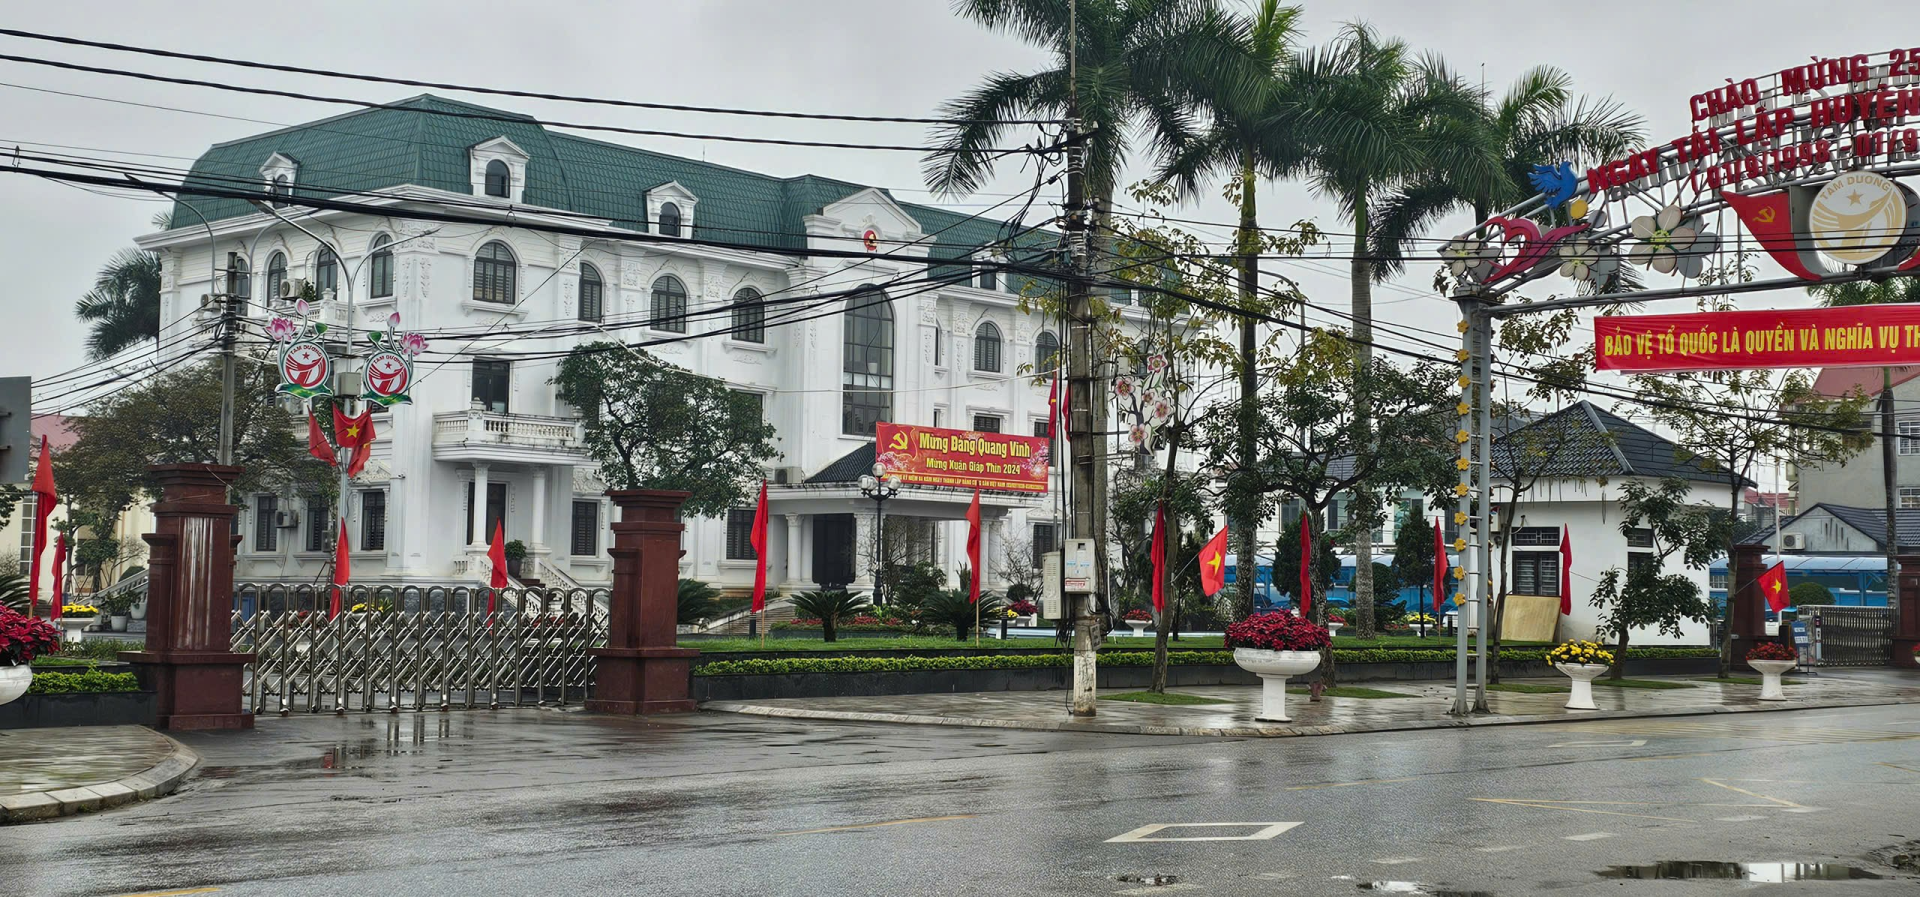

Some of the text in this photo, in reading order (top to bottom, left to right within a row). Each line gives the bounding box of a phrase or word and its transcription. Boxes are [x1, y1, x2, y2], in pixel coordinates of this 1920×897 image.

[1690, 48, 1920, 121] CHÀO MỪNG 25
[1587, 148, 1659, 194] NGÀY
[1735, 105, 1794, 146] LẬP
[1811, 84, 1920, 128] HUYỆN
[1820, 180, 1844, 200] TAM
[290, 346, 302, 355] TAM
[1604, 326, 1632, 356] BẢO
[1636, 330, 1653, 359] VỆ
[1658, 324, 1676, 355] TỔ
[1679, 324, 1718, 356] QUỐC
[1722, 326, 1740, 353] LÀ
[1745, 321, 1795, 355] QUYỀN
[1800, 323, 1819, 351] VÀ
[1824, 322, 1873, 350] NGHĨA
[1879, 325, 1899, 353] VỤ
[373, 356, 384, 364] TAM
[919, 432, 1031, 458] Mừng Đảng Quang Vinh
[926, 458, 947, 471] Mừng
[949, 459, 967, 471] Xuân
[969, 461, 984, 474] Giáp
[1003, 464, 1021, 475] 2024
